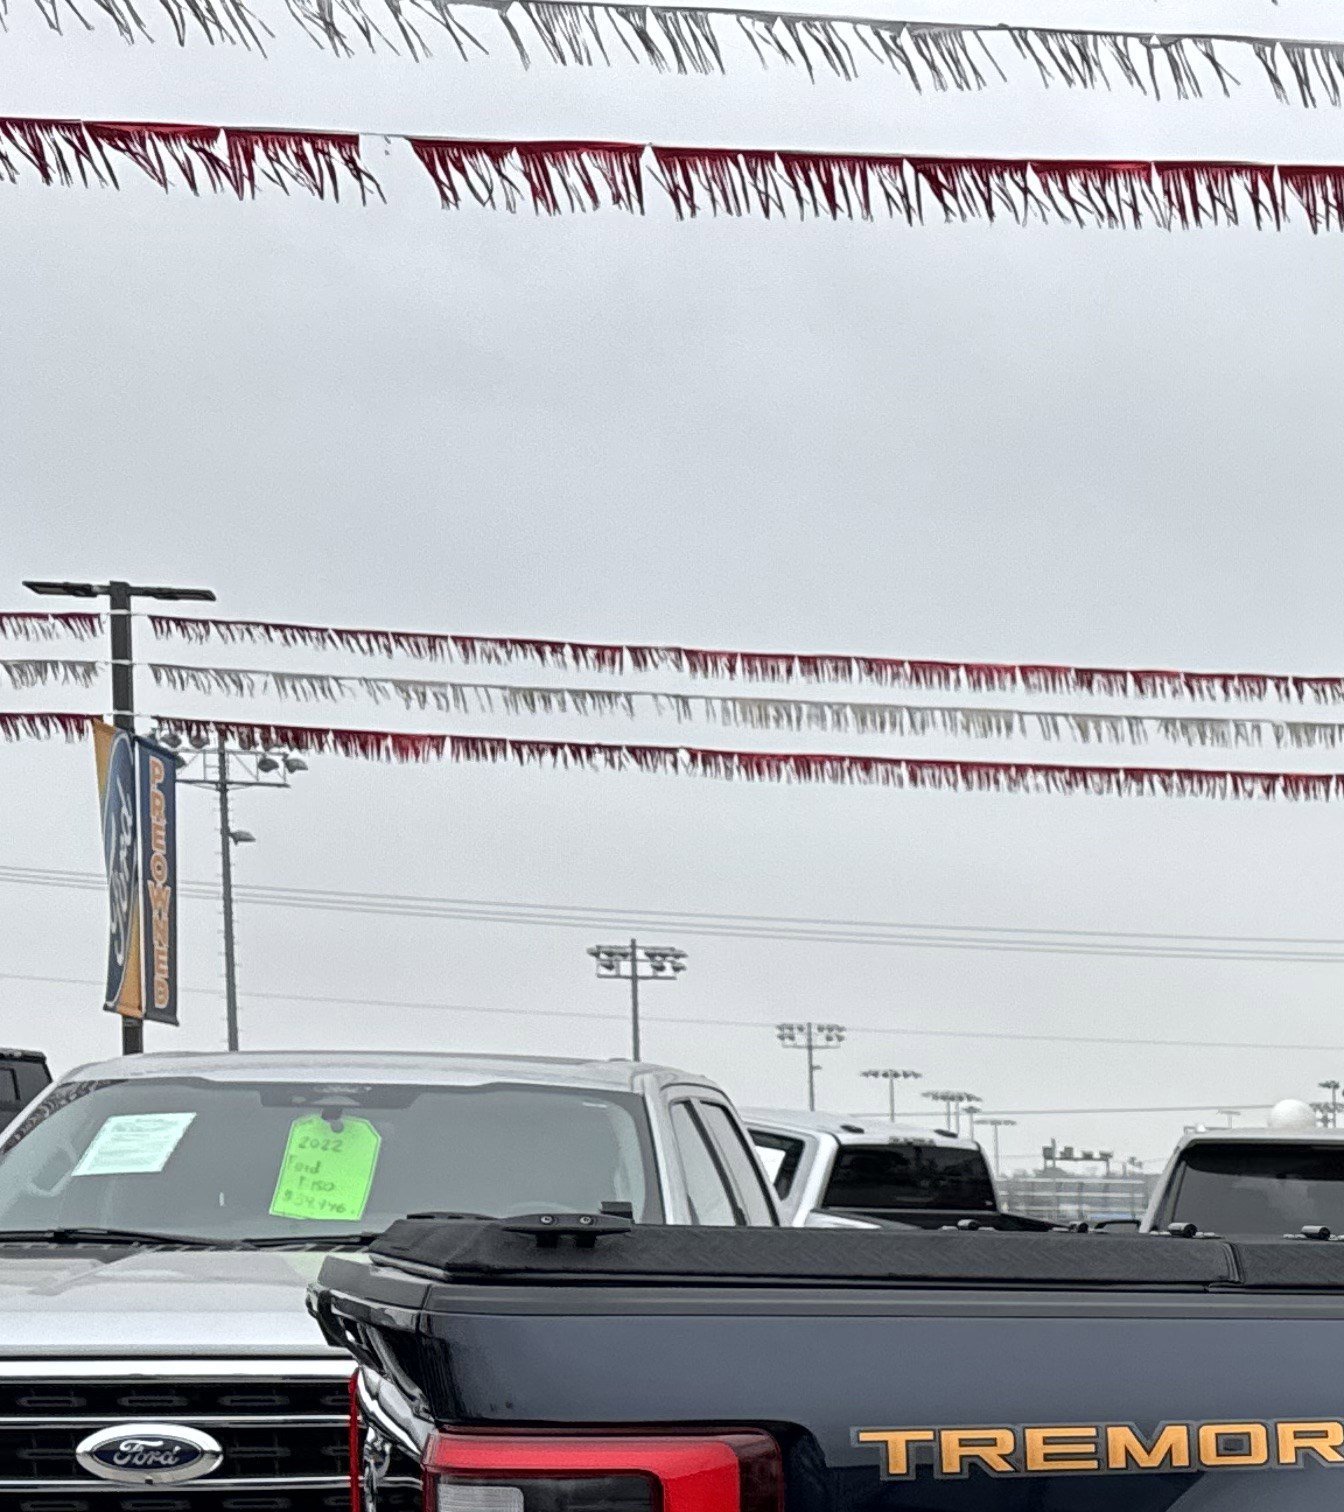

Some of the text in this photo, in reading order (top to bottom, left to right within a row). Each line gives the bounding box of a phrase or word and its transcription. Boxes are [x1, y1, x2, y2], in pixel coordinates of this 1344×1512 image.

[111, 774, 133, 967] Ford
[298, 1136, 343, 1153] 2022
[113, 1439, 182, 1465] Ford
